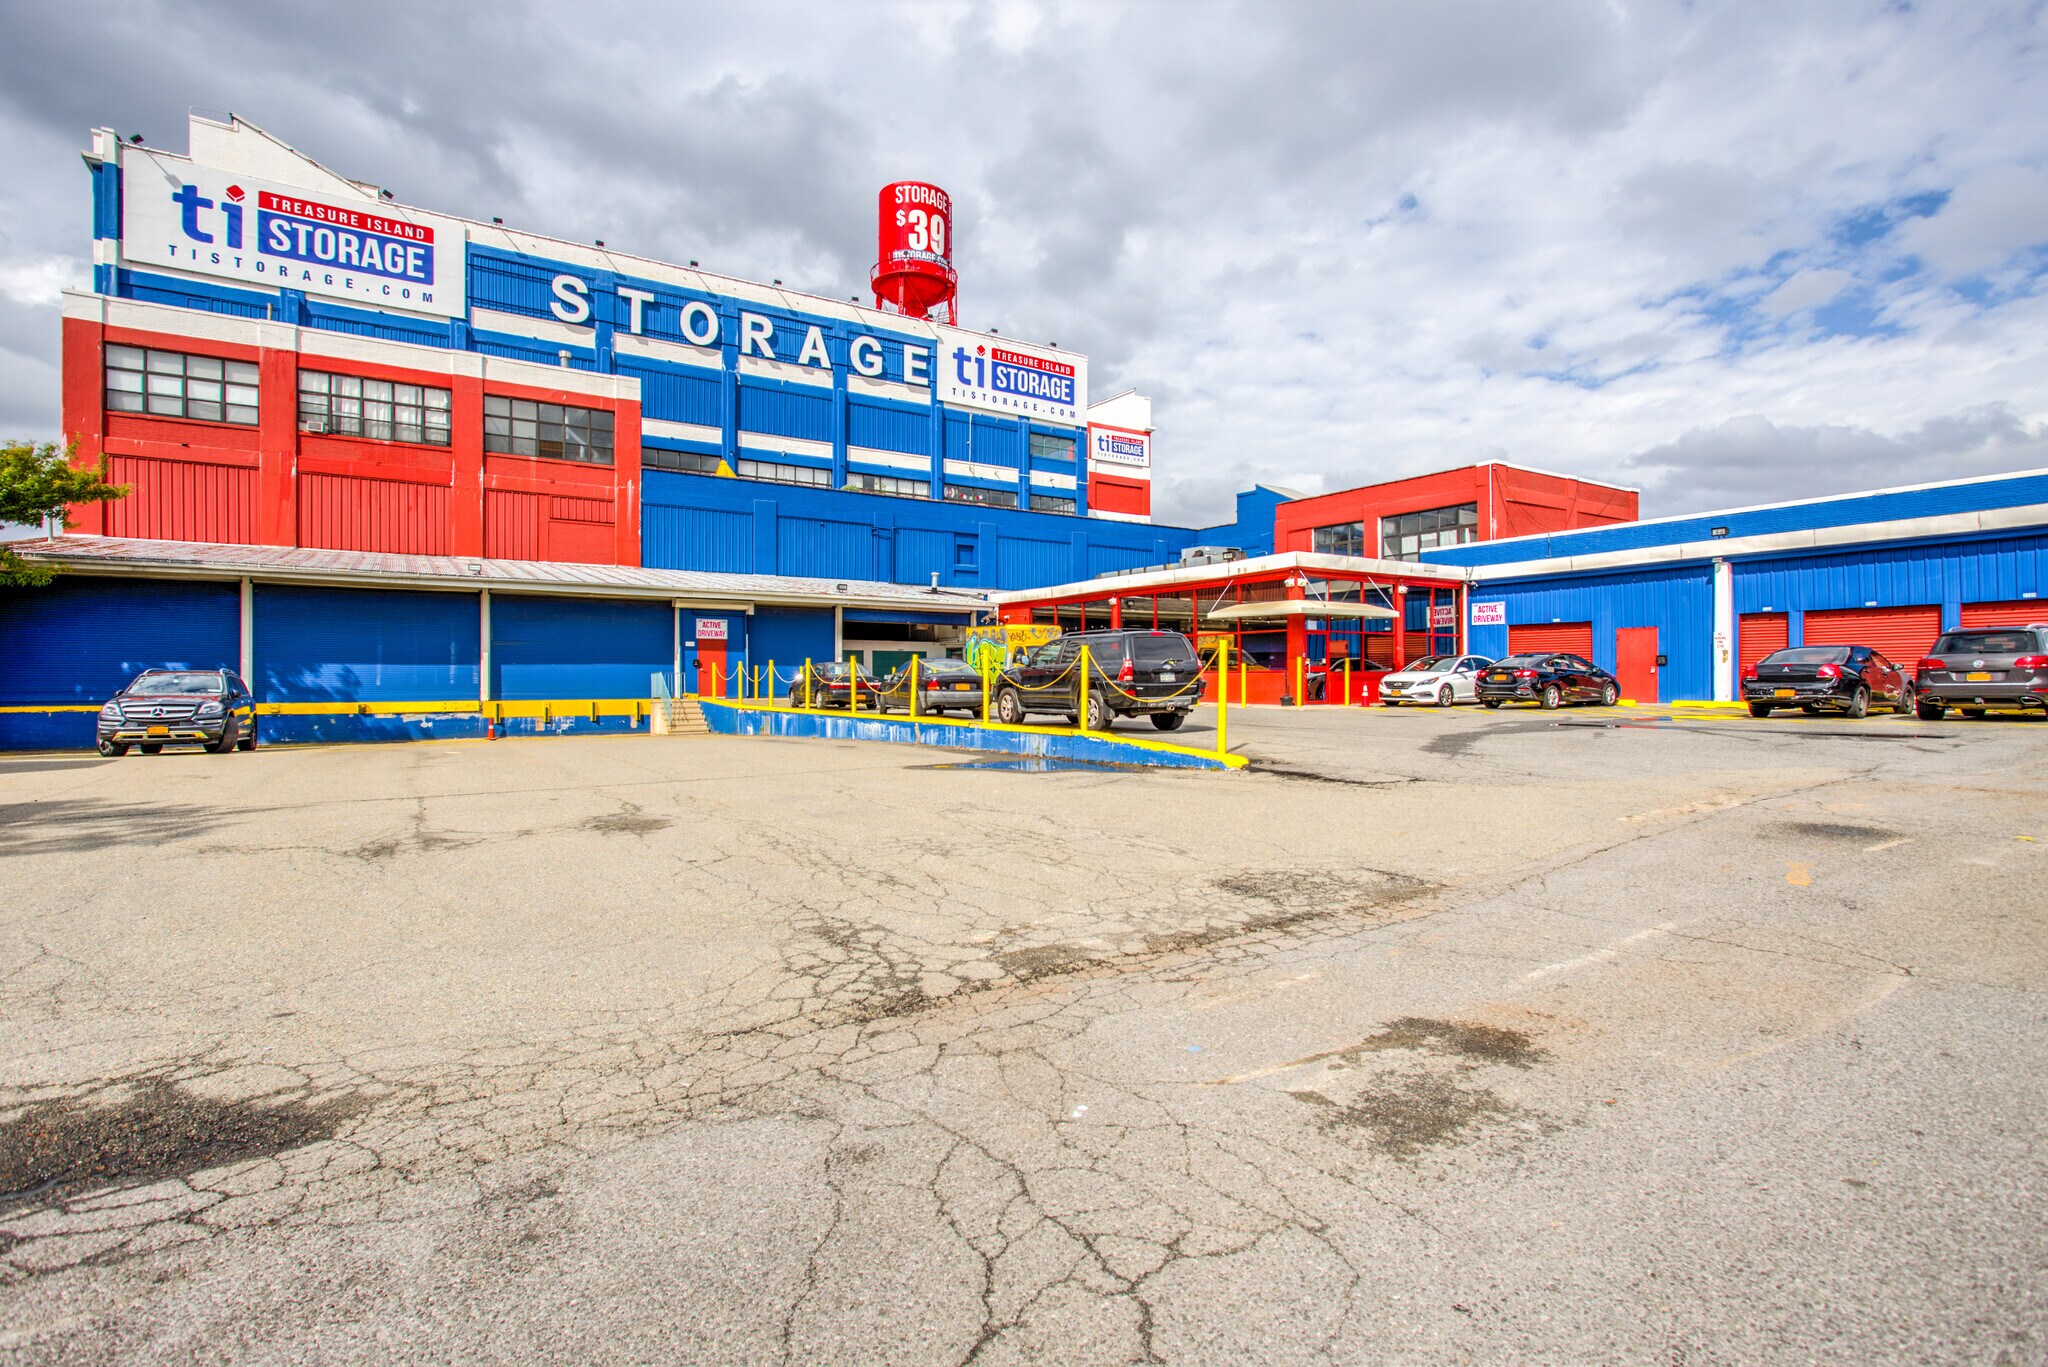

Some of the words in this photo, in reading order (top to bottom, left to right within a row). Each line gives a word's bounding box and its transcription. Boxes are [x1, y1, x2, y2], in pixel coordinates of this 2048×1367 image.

[172, 184, 245, 250] ti
[270, 197, 358, 226] TREASURE
[366, 218, 425, 240] ISLAND
[895, 185, 947, 214] STORAGE
[269, 218, 425, 279] STORAGE
[896, 209, 945, 256] $39
[168, 244, 433, 303] TISTORAGE.COM
[550, 274, 930, 386] STORAGE
[952, 344, 986, 388] ti
[996, 350, 1039, 368] TREASURE
[1041, 361, 1071, 375] ISLAND
[952, 387, 1076, 419] TISTORAGE.COM
[996, 367, 1071, 401] STORAGE
[1113, 442, 1143, 456] STORAGE
[1473, 614, 1503, 623] DRIVEWAY
[1478, 605, 1497, 613] ACTIVE
